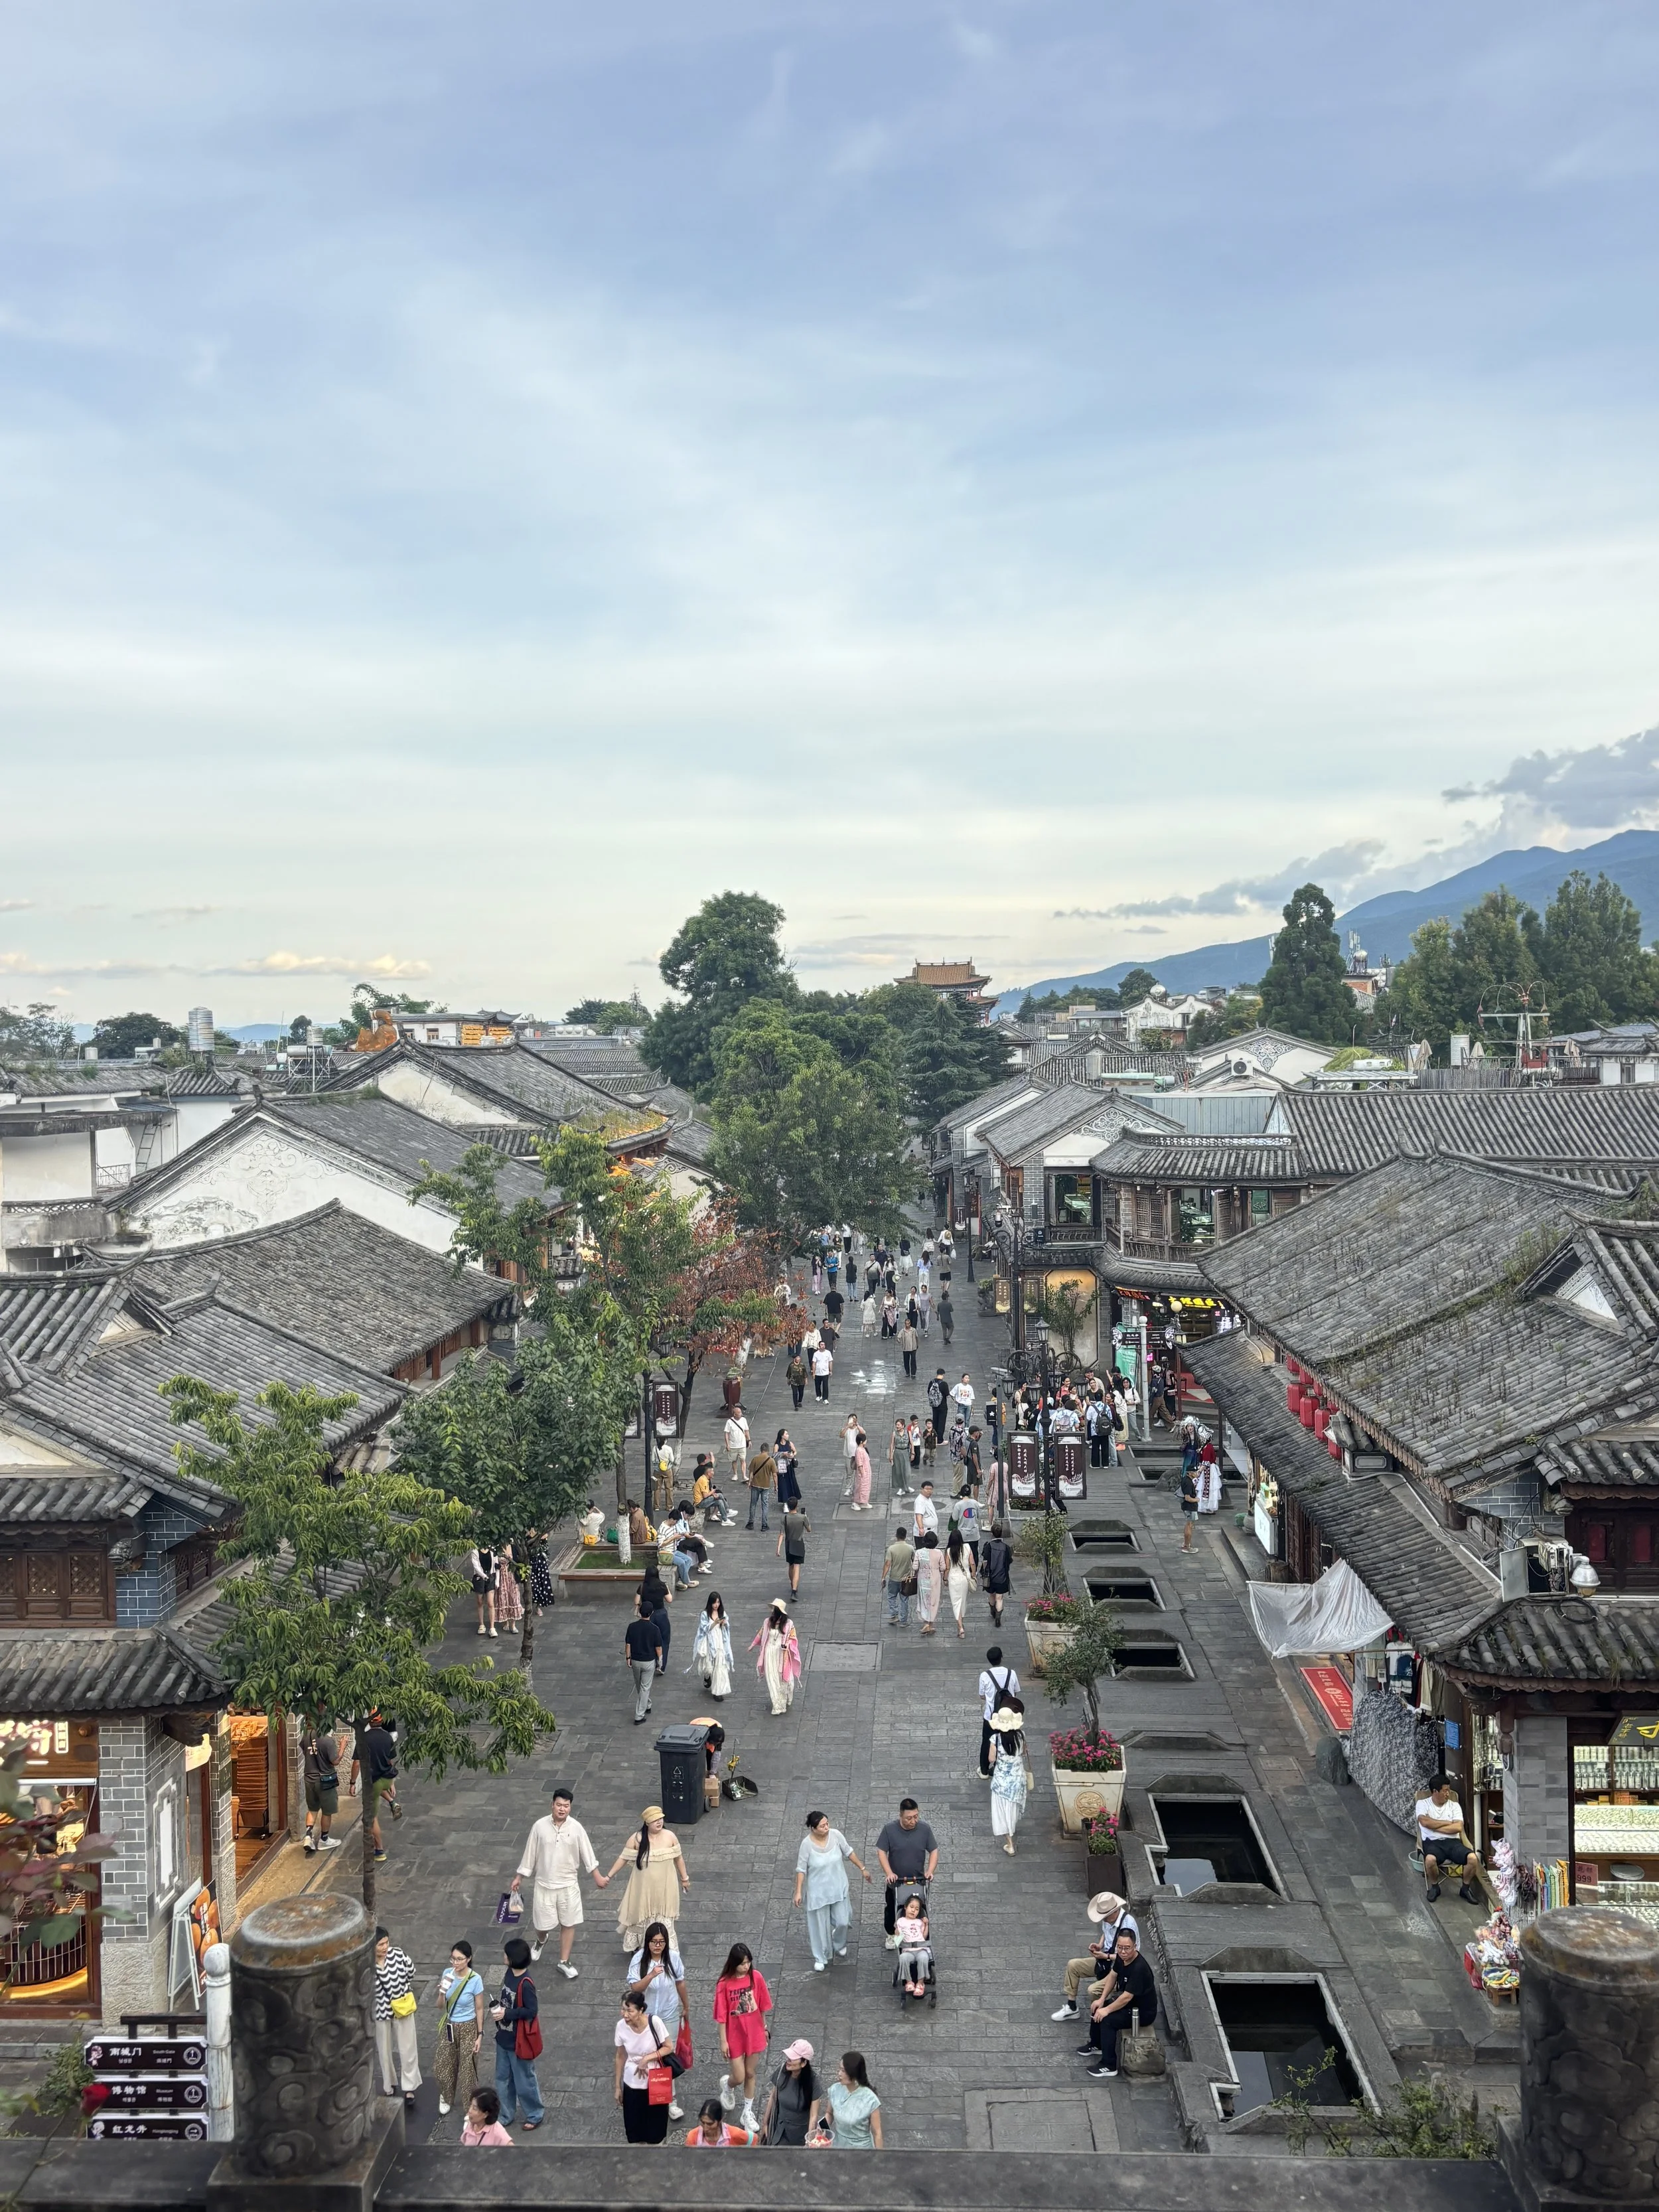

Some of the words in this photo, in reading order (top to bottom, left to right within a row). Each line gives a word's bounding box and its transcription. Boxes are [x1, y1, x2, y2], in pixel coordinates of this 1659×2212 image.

[1577, 1874, 1592, 1883] 999
[109, 2047, 142, 2056] 南城门
[111, 2085, 147, 2095] 博物馆
